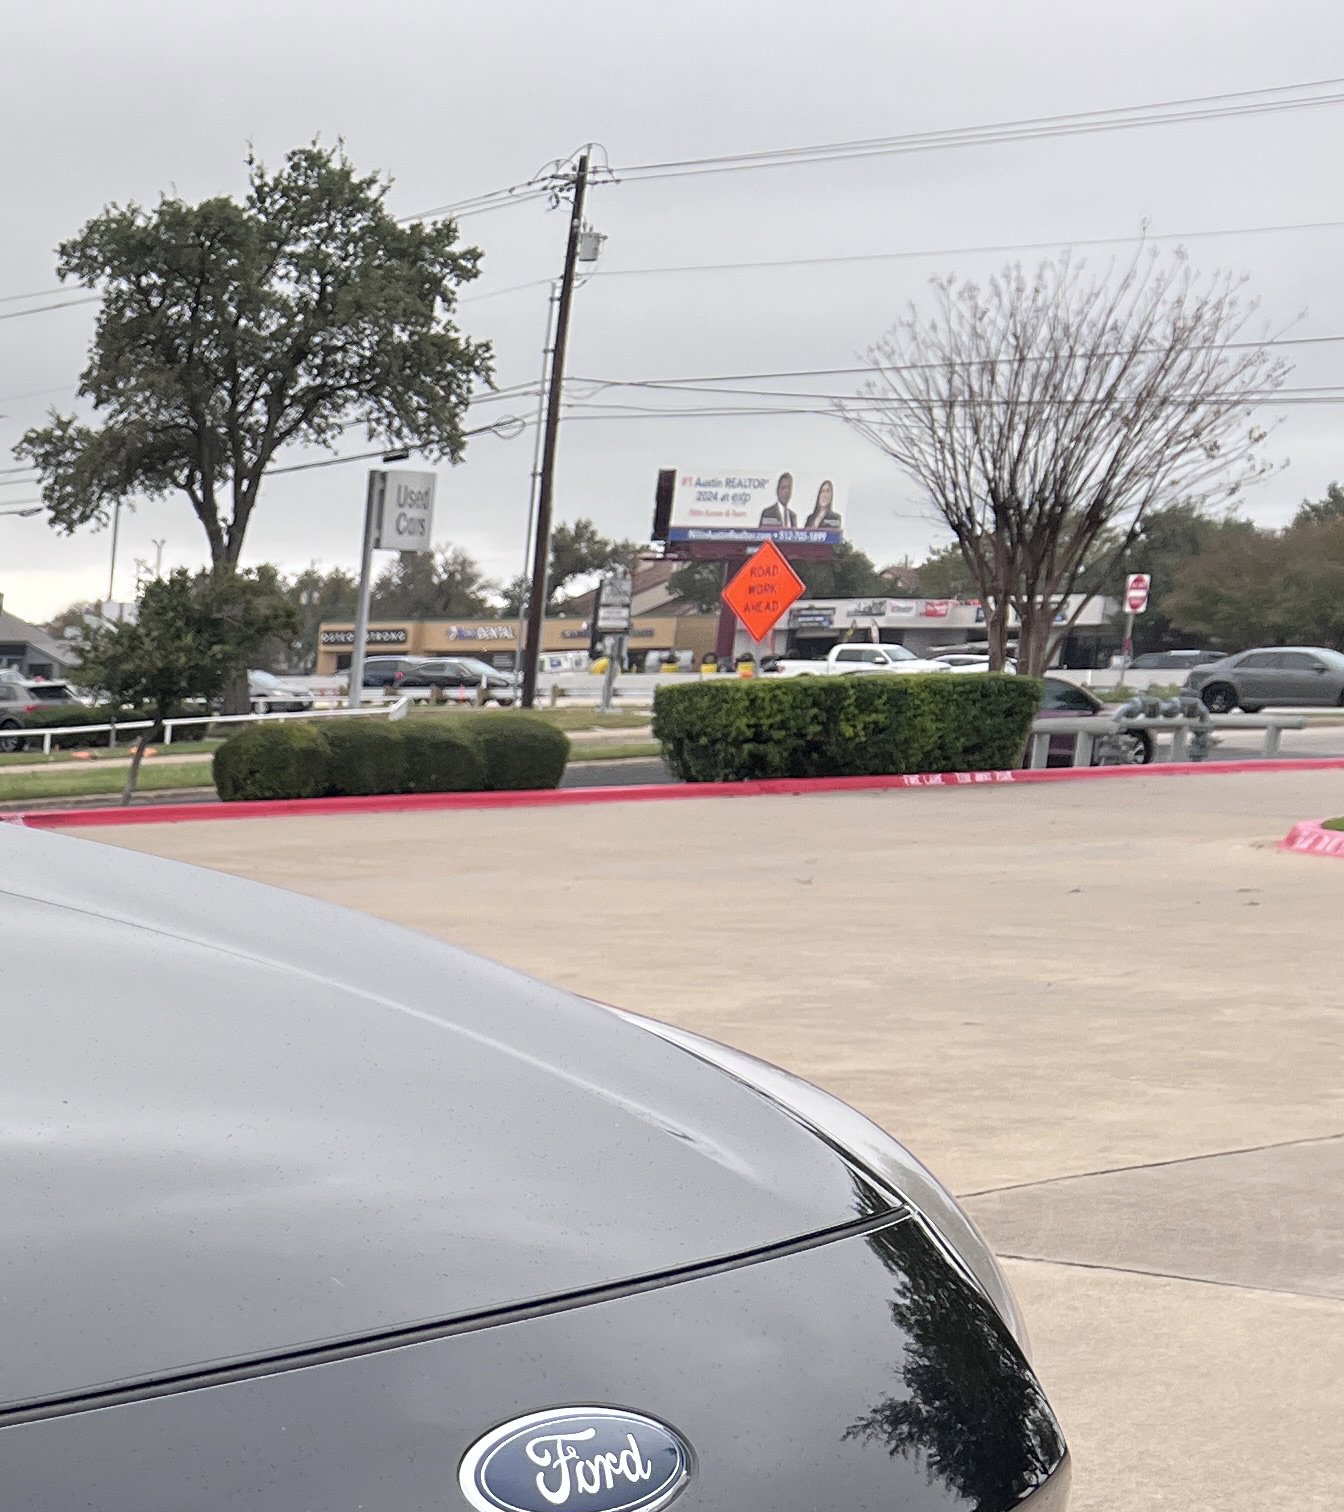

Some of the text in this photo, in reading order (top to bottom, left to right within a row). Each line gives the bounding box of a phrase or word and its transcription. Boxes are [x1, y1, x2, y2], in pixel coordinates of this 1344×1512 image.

[695, 477, 723, 489] Austin
[397, 484, 431, 510] Used
[696, 490, 719, 502] 2024
[750, 565, 779, 578] ROAD
[748, 583, 777, 595] WORK
[744, 600, 779, 614] AHEAD
[525, 1427, 652, 1505] Ford
